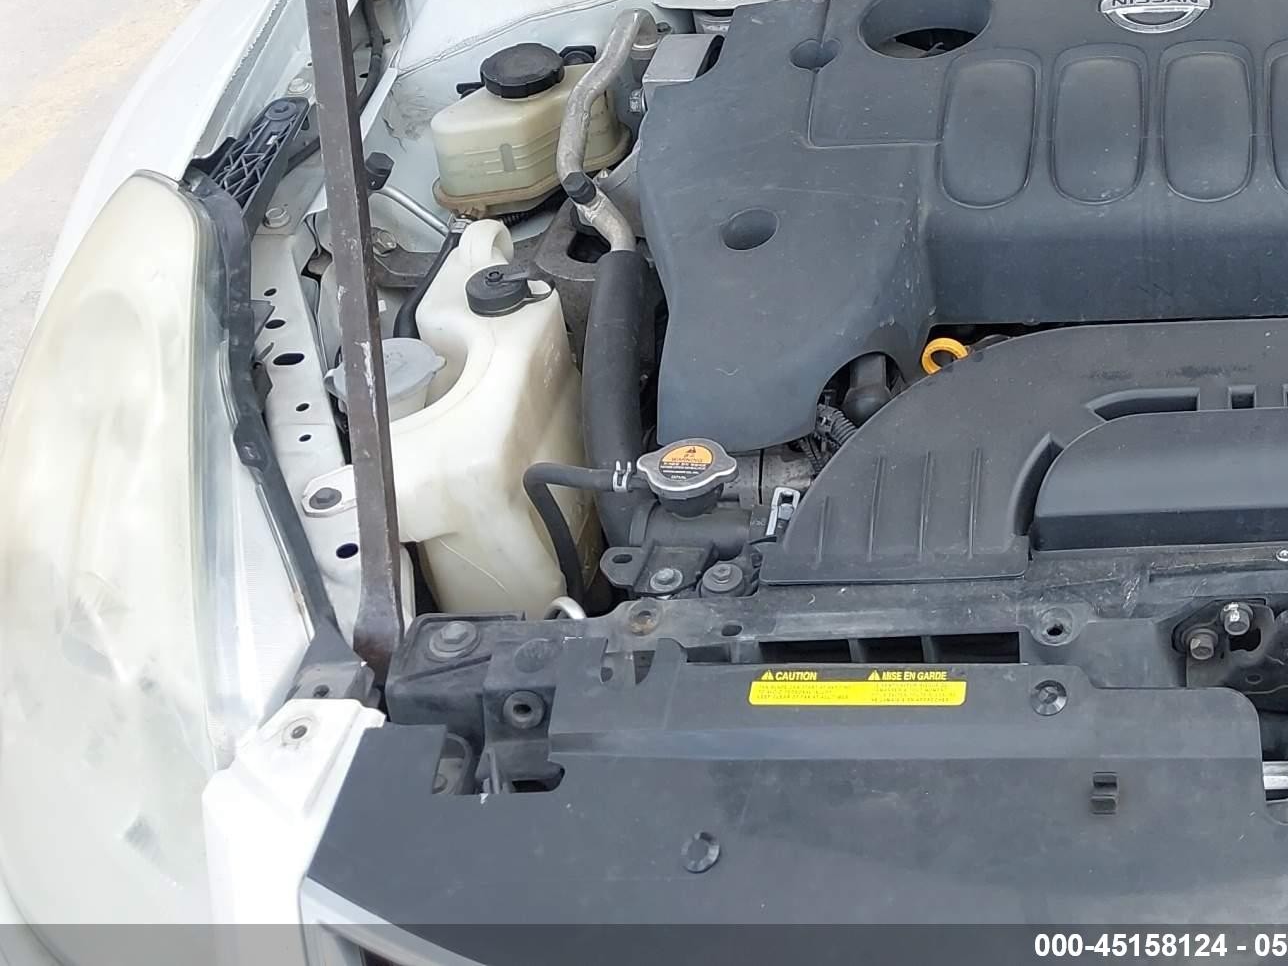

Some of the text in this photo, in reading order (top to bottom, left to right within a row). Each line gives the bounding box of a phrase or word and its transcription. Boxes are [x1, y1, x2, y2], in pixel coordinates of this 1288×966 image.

[775, 671, 818, 681] CAUTION
[882, 671, 948, 681] MISE EN GARDE
